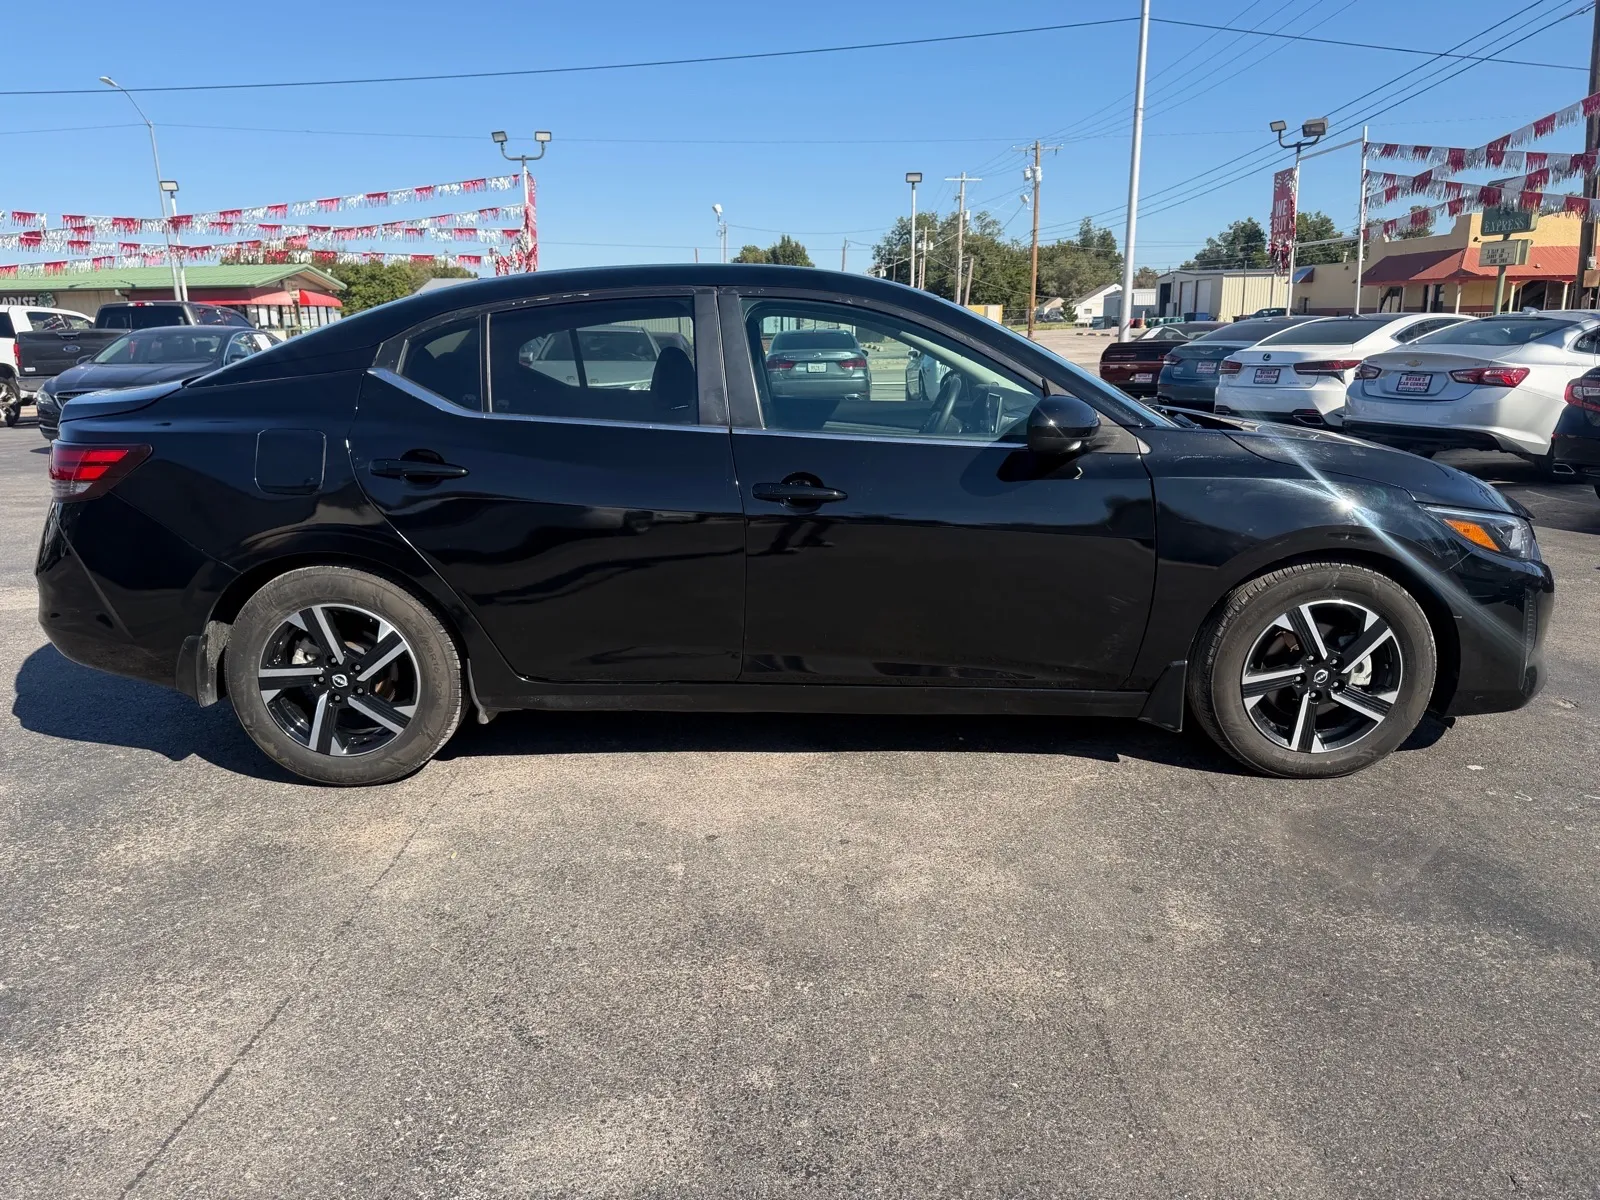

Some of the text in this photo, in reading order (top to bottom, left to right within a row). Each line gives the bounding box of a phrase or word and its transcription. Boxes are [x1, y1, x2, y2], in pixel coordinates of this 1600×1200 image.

[1275, 199, 1288, 217] WE
[1273, 216, 1288, 233] BUY
[1484, 217, 1525, 233] EXPRESS
[0, 296, 37, 306] ADISE
